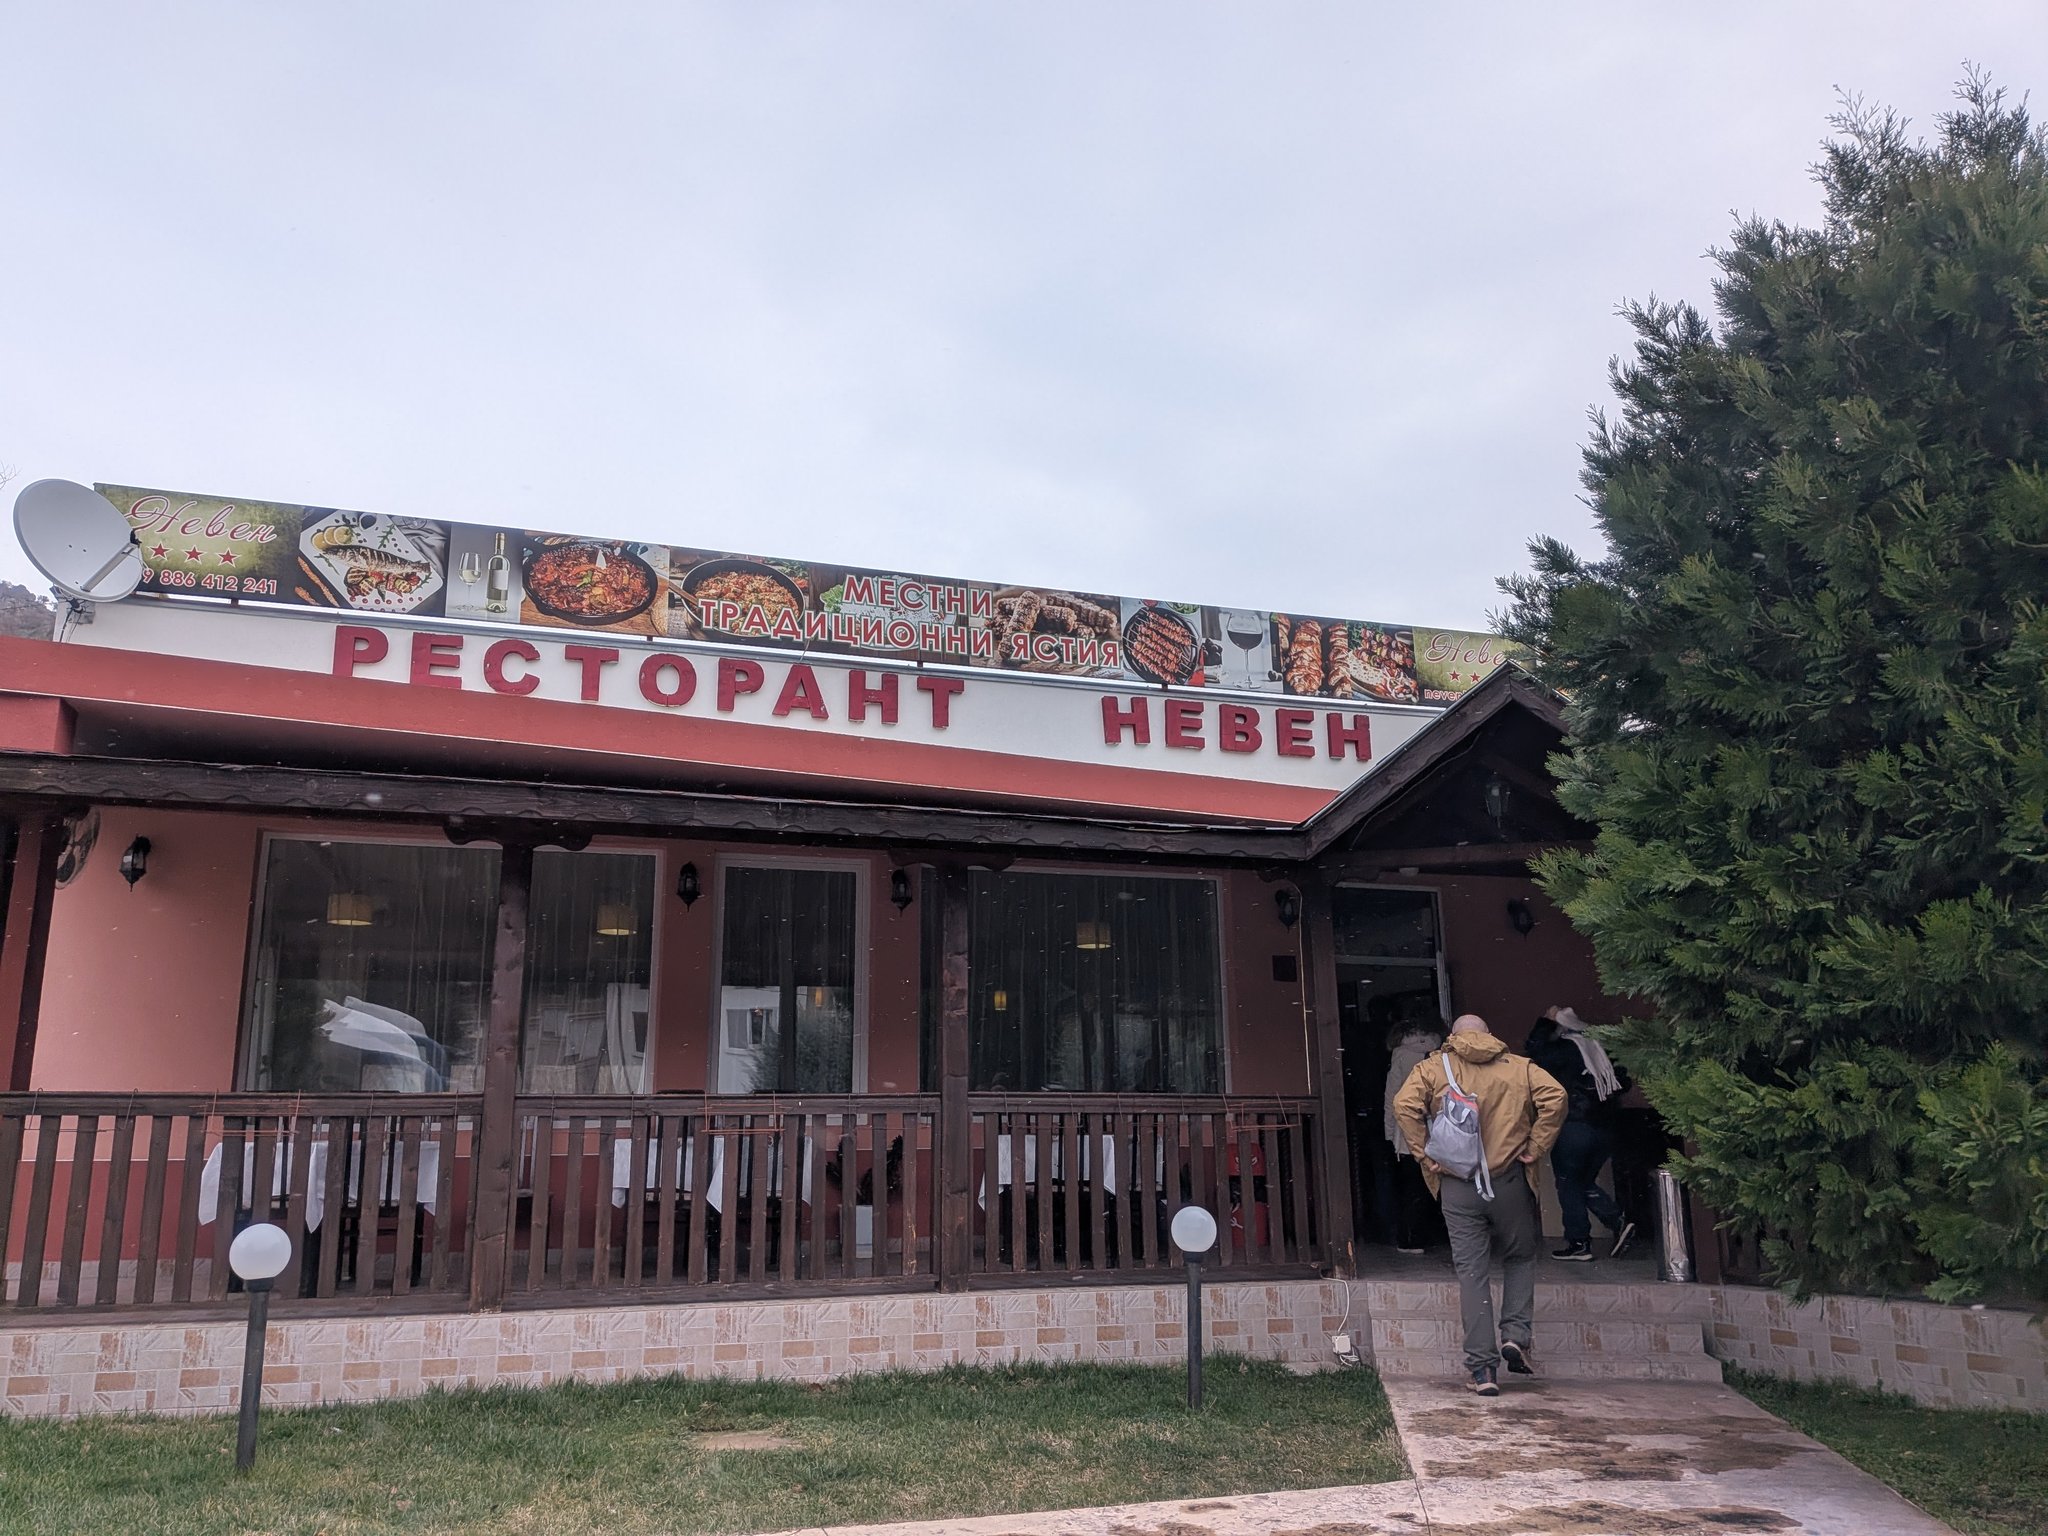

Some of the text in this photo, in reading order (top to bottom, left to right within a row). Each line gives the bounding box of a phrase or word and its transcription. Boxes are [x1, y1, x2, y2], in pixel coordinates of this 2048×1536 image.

[126, 495, 277, 543] Невен
[160, 569, 196, 588] 886
[201, 573, 237, 592] 412
[242, 577, 277, 595] 241
[842, 574, 993, 619] МЕСТНИ
[699, 598, 1120, 668] ТРАДИЦИОННИ ЯСТИЯ
[1425, 632, 1505, 665] Неве
[332, 625, 1373, 761] РЕСТОРАНТ НЕВЕН
